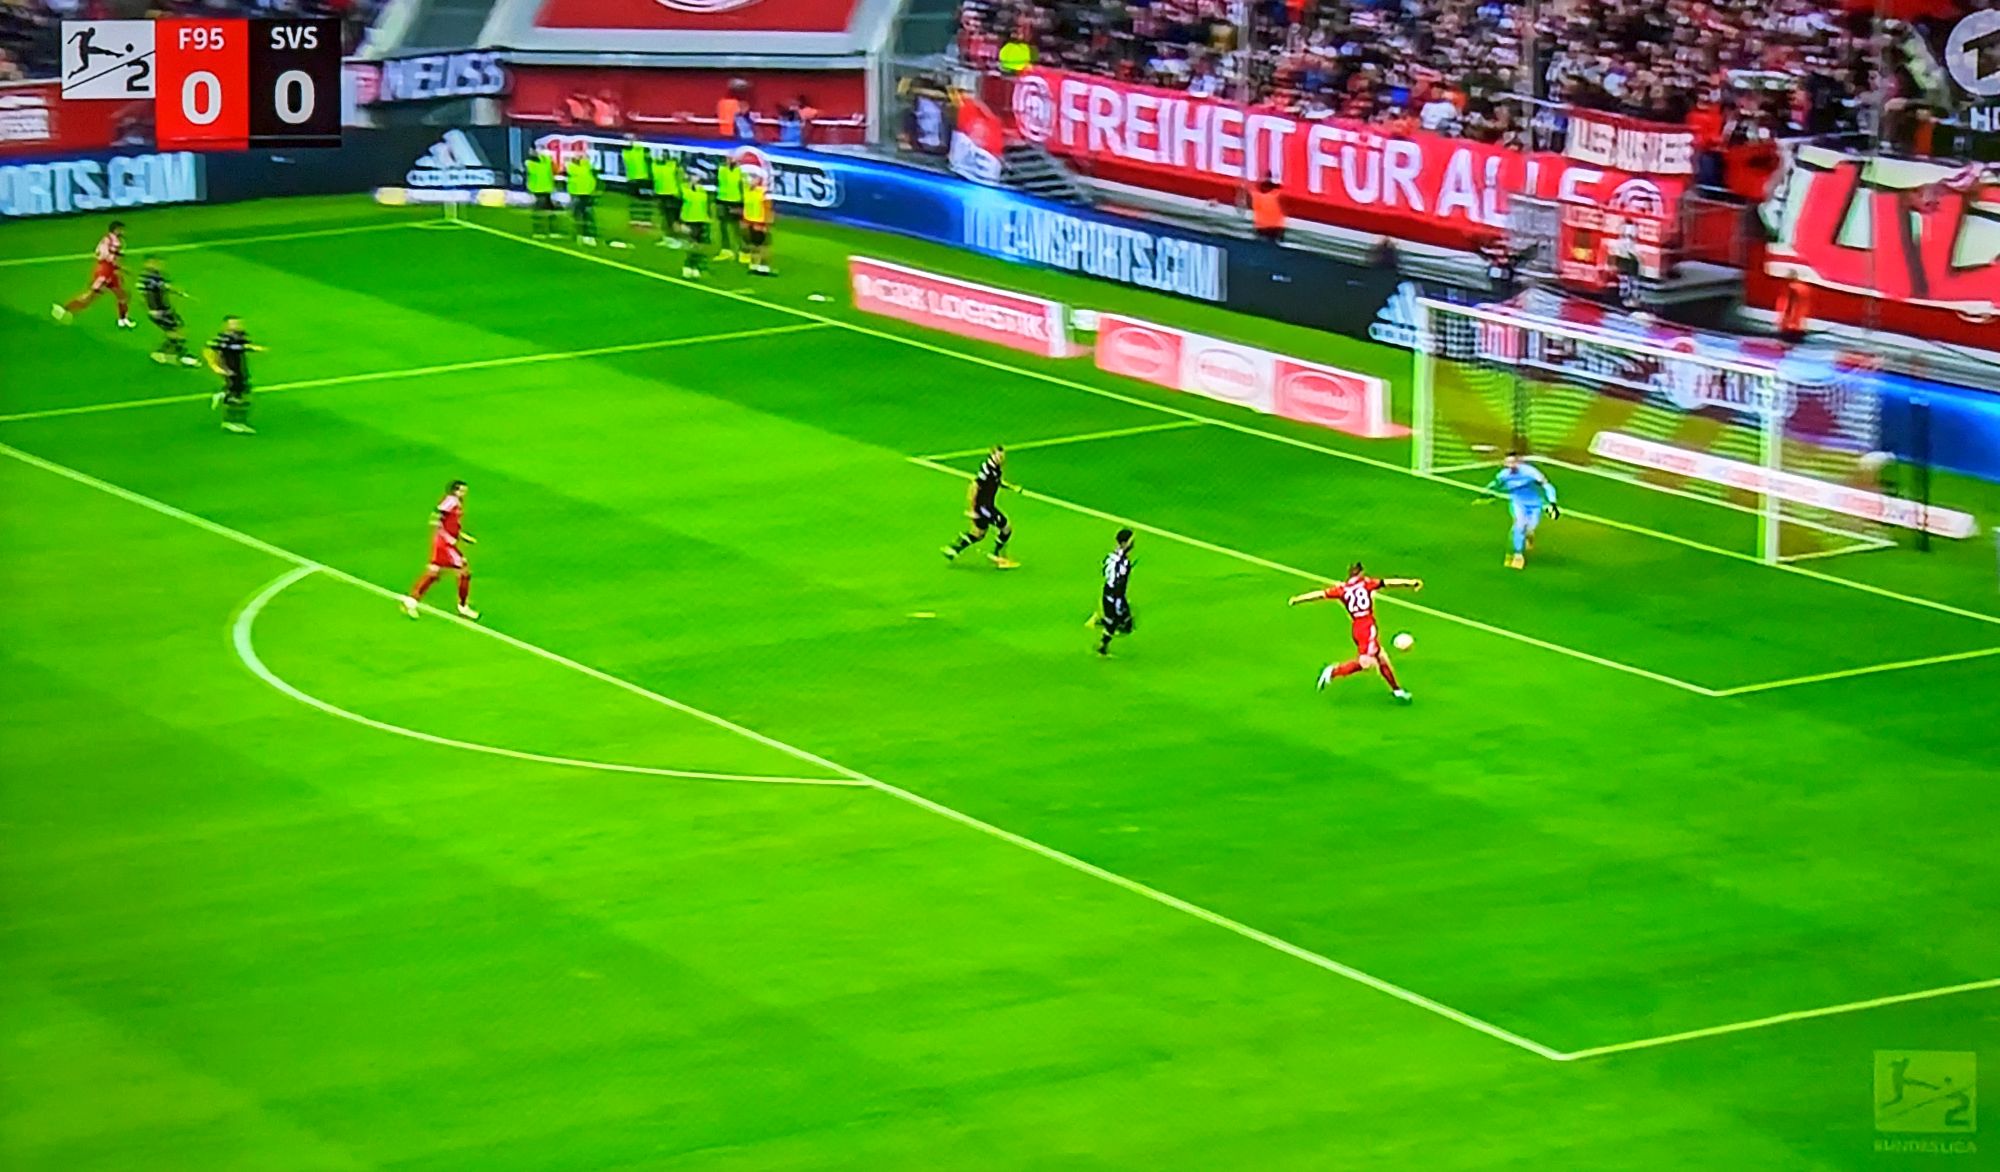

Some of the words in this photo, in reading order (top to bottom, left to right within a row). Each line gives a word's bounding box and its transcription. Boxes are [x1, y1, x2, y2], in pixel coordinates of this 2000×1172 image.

[1060, 79, 1297, 185] FREIHEIT
[1306, 123, 1425, 213] FÜR
[1343, 582, 1371, 612] 28
